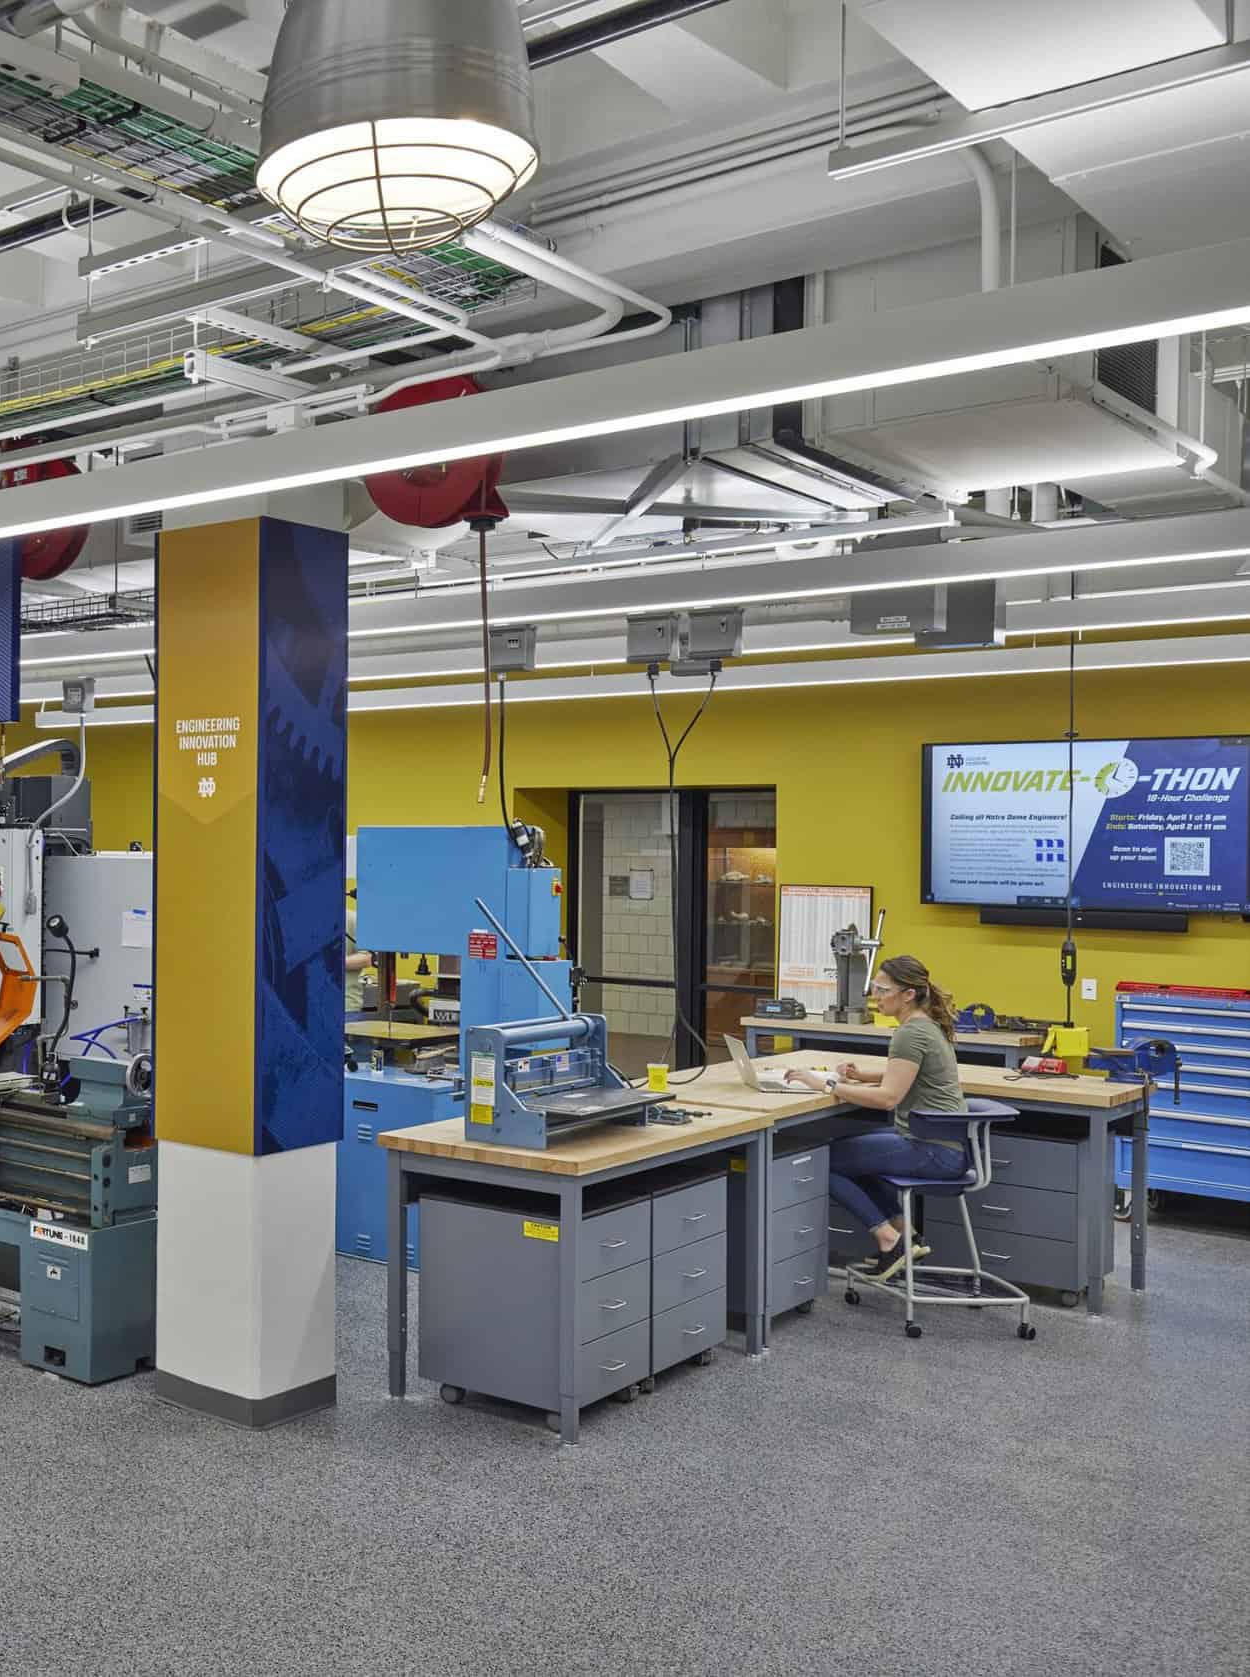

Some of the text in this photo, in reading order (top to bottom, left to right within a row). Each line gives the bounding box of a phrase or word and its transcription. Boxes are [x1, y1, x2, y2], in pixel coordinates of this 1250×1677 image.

[176, 717, 240, 733] ENGINEERING
[179, 735, 236, 749] INNOVATION
[197, 751, 217, 766] HUB
[1102, 881, 1153, 890] ENGINEERING
[1156, 883, 1203, 891] INNOVATION
